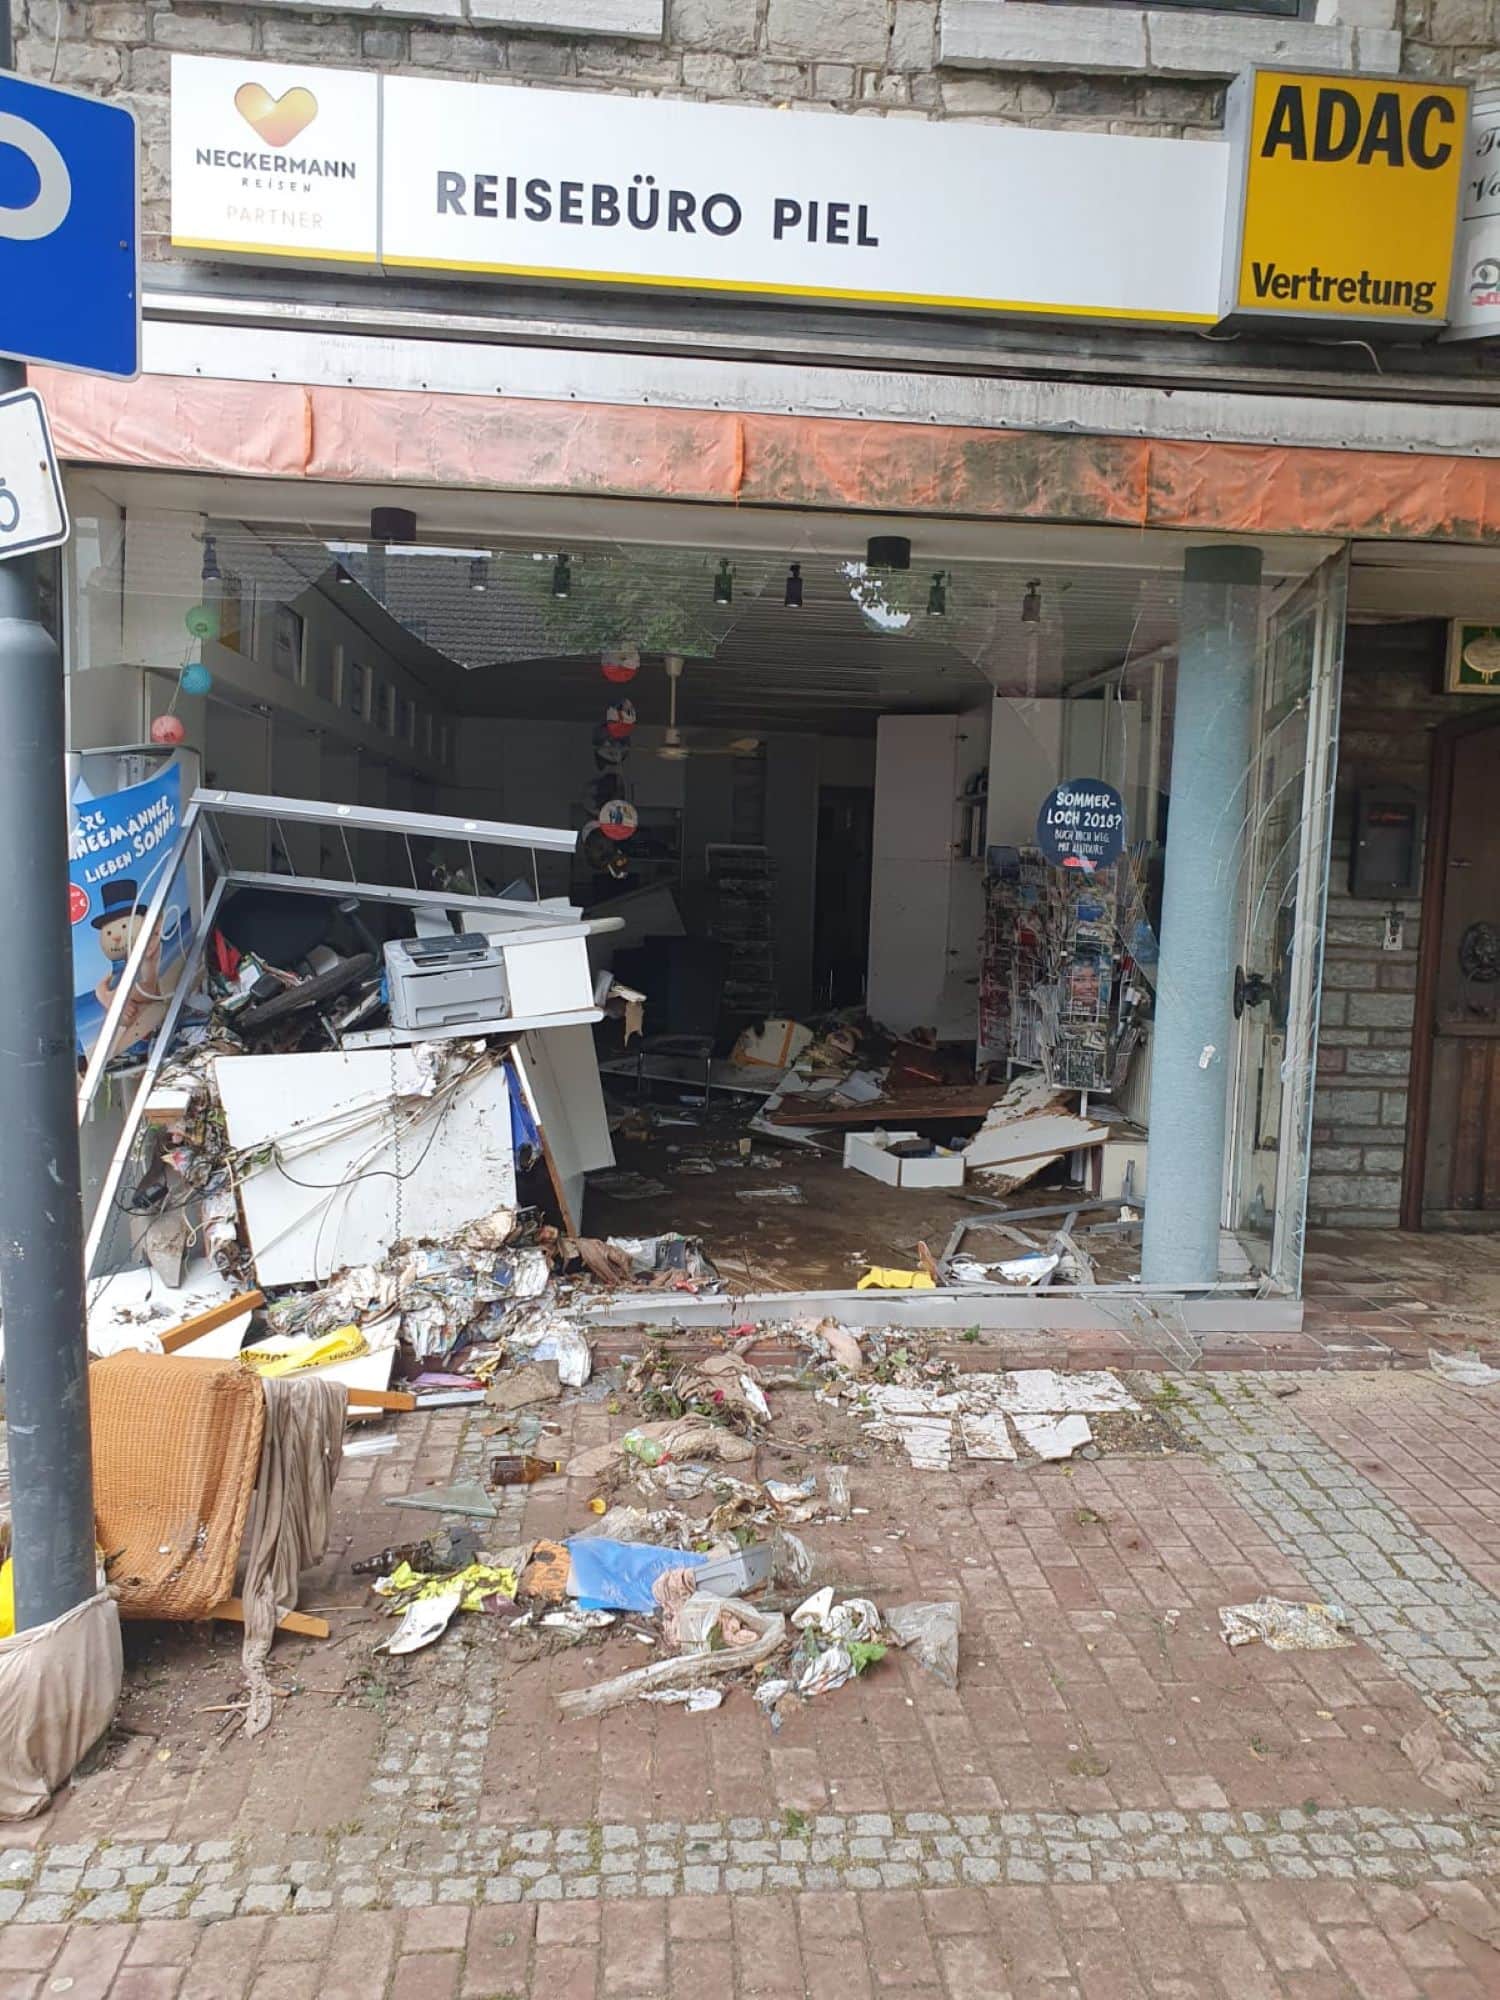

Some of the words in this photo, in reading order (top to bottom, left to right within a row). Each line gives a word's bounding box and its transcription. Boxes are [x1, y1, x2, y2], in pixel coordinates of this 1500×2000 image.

[1261, 85, 1455, 170] ADAC
[196, 148, 356, 179] NECKERMANN
[241, 177, 312, 193] REISEN
[227, 204, 323, 229] PARTNER
[436, 171, 742, 236] REISEBÜRO
[773, 198, 879, 247] PIEL
[1252, 262, 1436, 314] Vertretung
[1056, 791, 1117, 809] SOMMER-
[1046, 808, 1080, 825] LOCH
[85, 851, 133, 883] LIEBEN
[133, 805, 176, 858] SONNE
